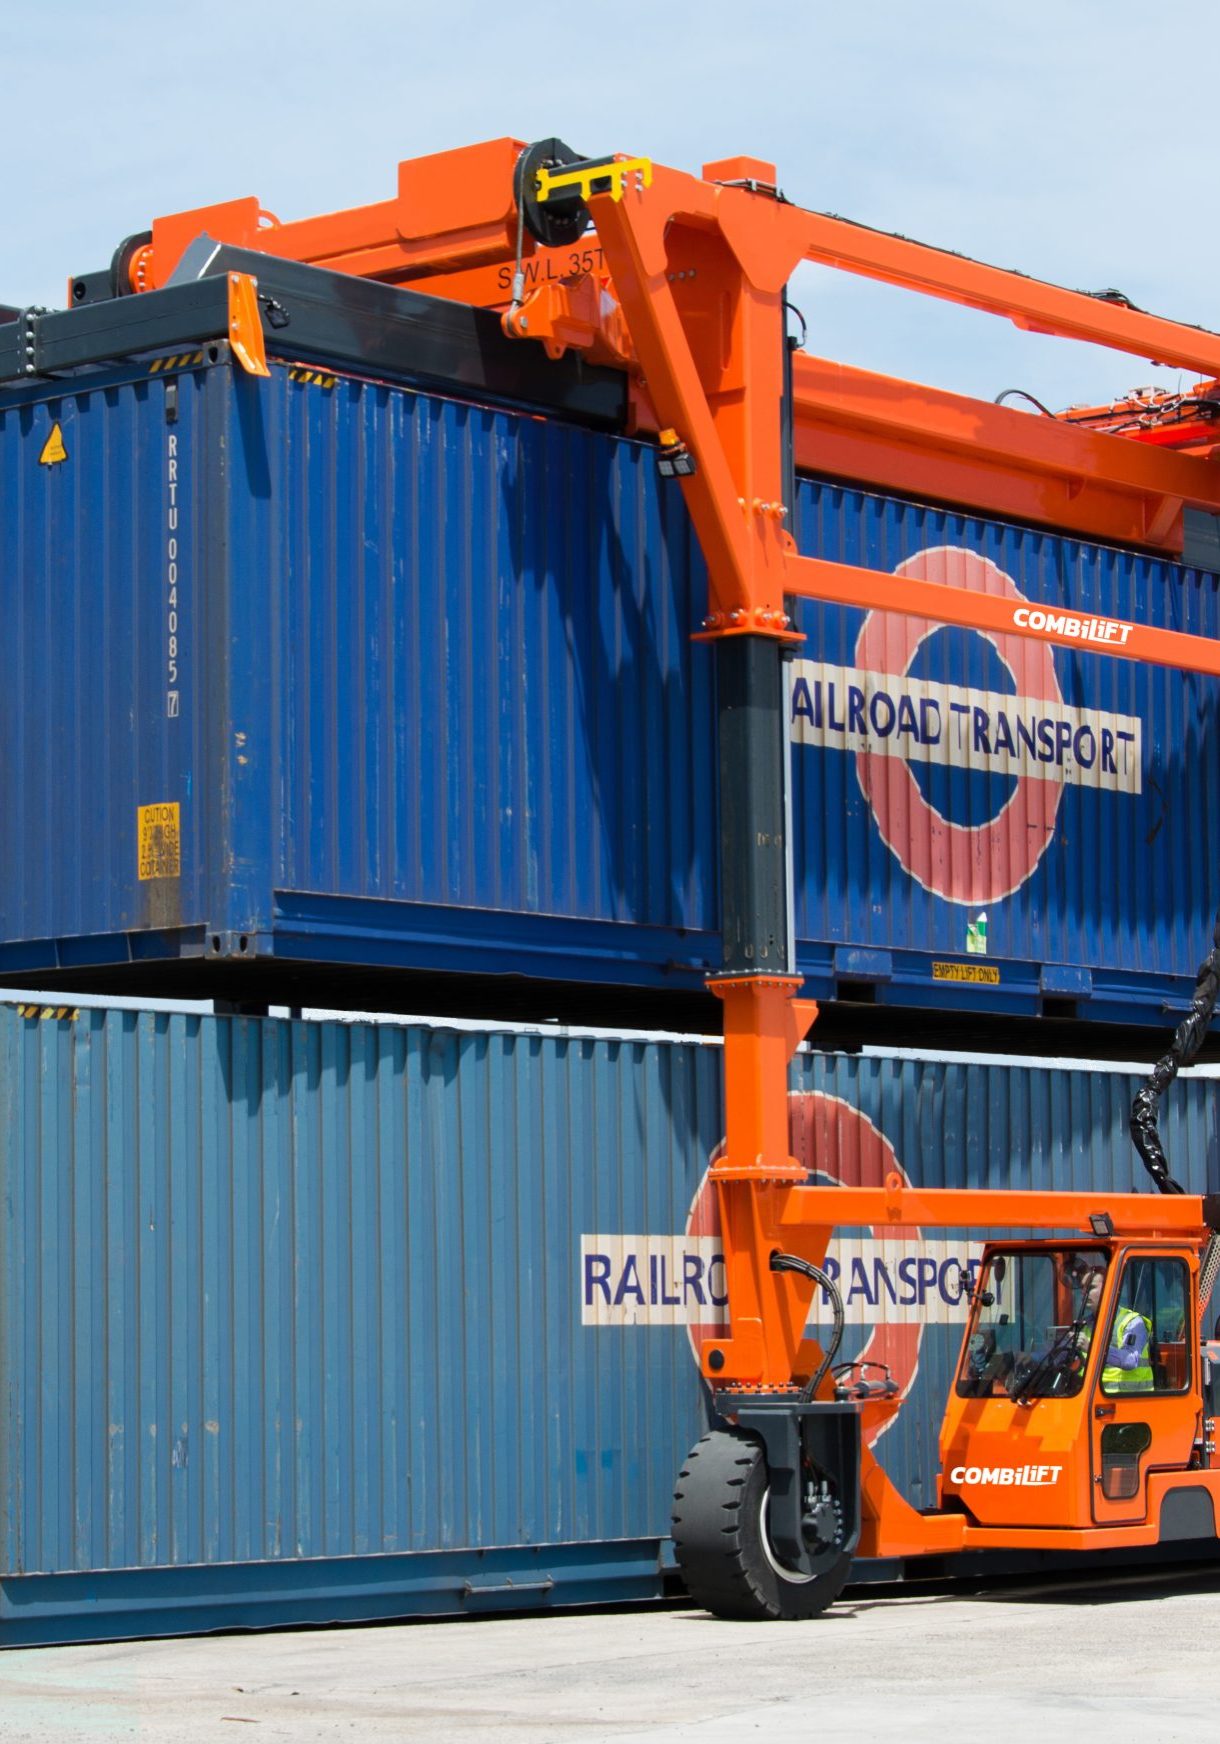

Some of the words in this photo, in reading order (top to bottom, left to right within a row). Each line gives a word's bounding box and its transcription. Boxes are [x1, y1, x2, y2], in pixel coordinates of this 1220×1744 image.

[497, 258, 564, 289] SW.L.
[568, 248, 604, 277] 35T
[168, 434, 178, 530] RRTU
[168, 538, 178, 683] 004085
[168, 691, 179, 717] 7
[791, 677, 942, 745] AILROAD
[950, 702, 1135, 776] TRANSPORT
[933, 963, 960, 980] EMPTY
[961, 965, 977, 982] LIFT
[978, 967, 998, 983] ONLY
[584, 1254, 729, 1307] RAILRO
